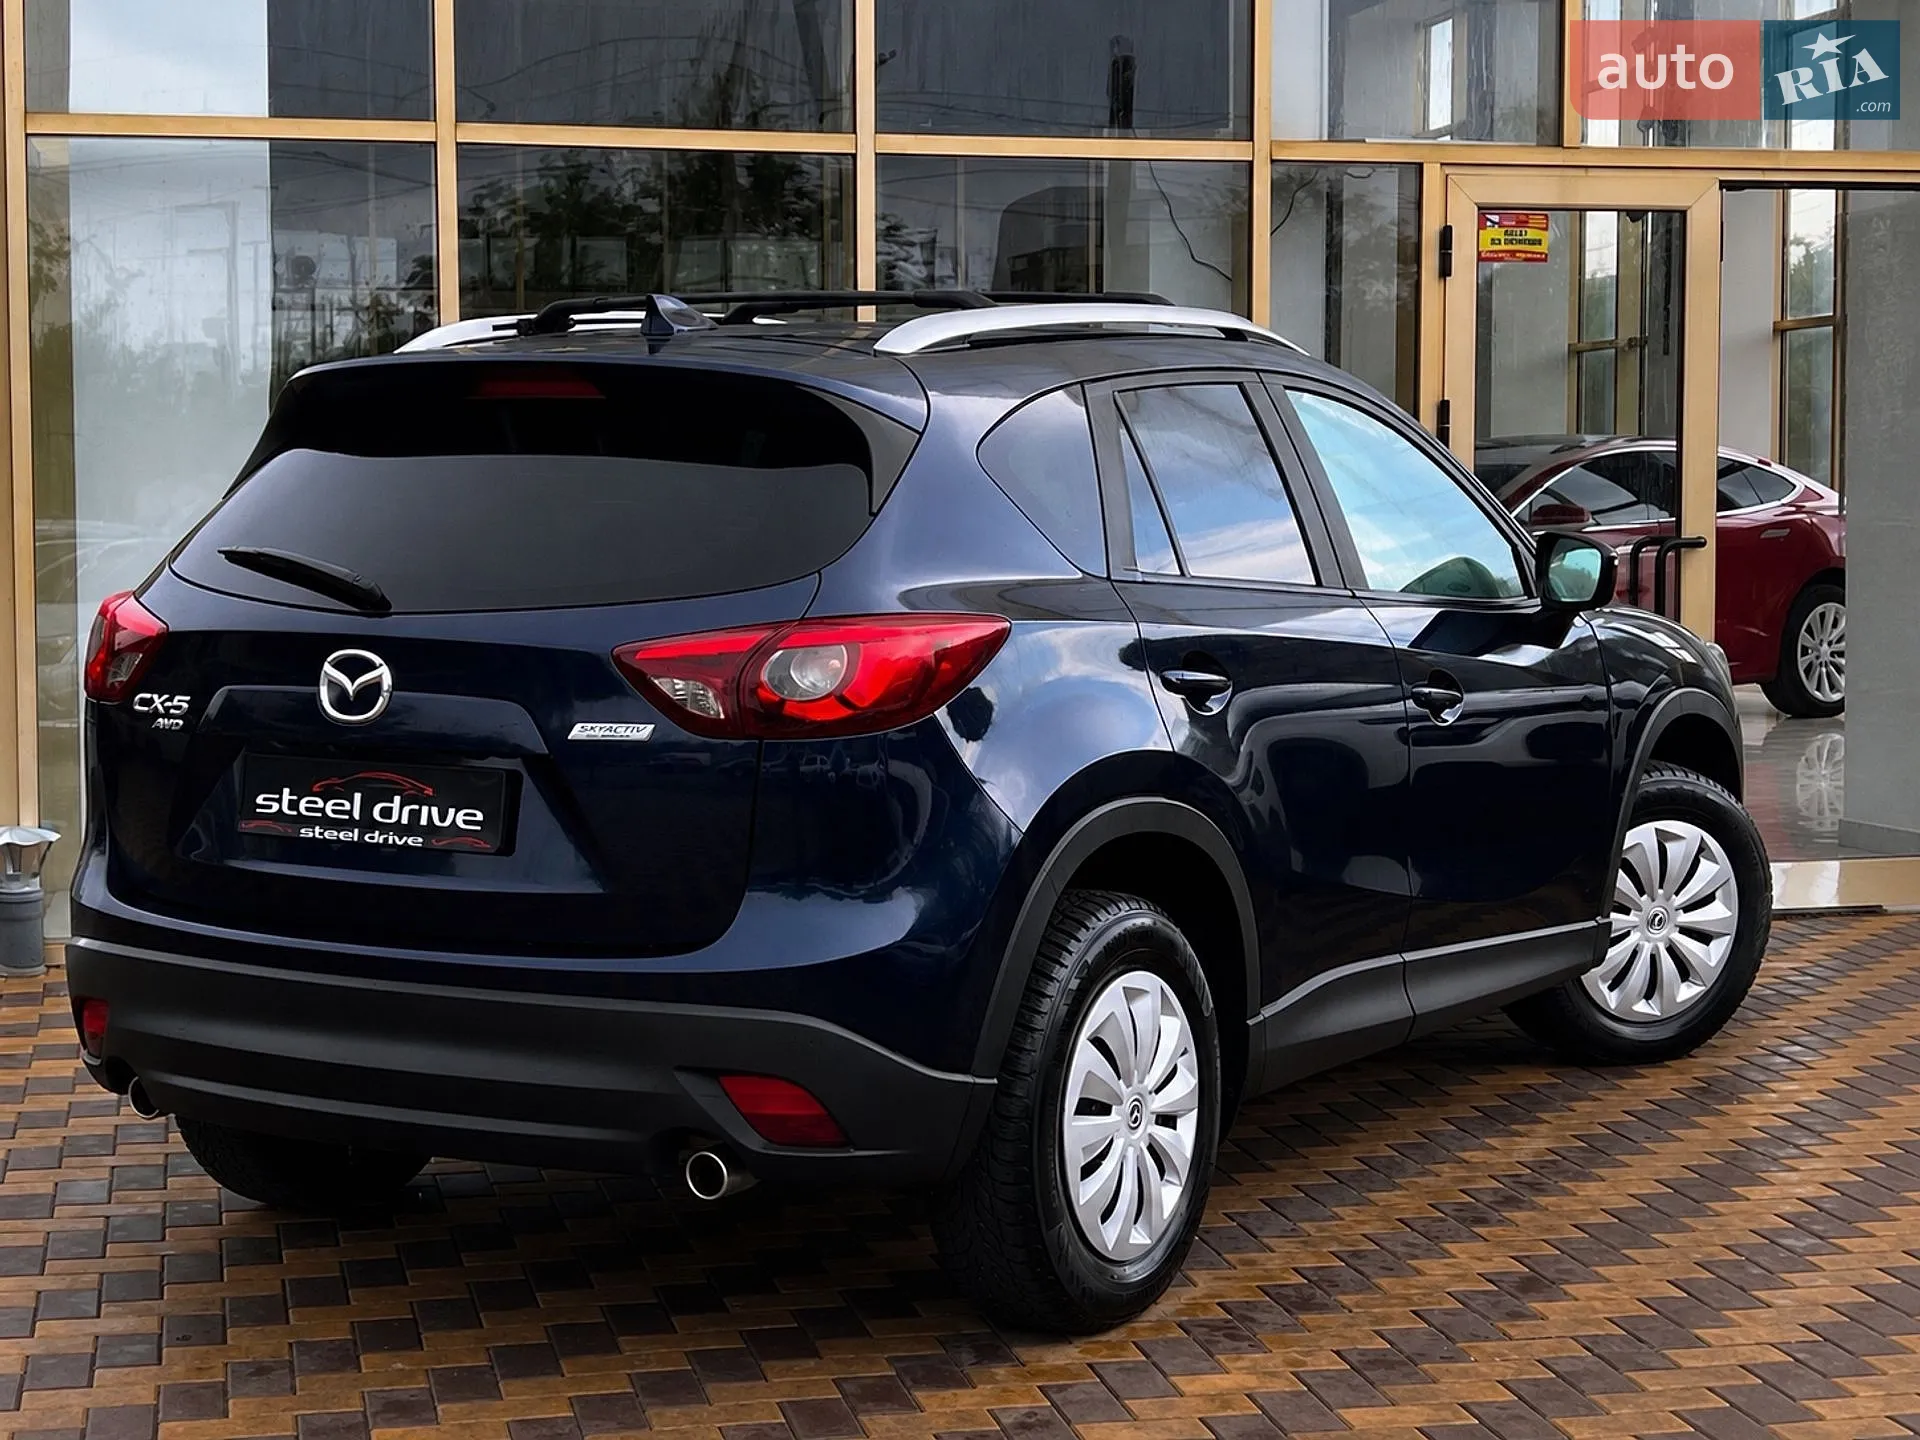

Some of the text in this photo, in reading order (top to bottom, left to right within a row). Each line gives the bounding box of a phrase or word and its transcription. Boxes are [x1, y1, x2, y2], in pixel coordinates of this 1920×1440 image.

[133, 693, 191, 715] CX-5
[578, 725, 647, 734] SKYACTIV
[255, 787, 484, 831] steel drive
[299, 826, 423, 847] steel drive
